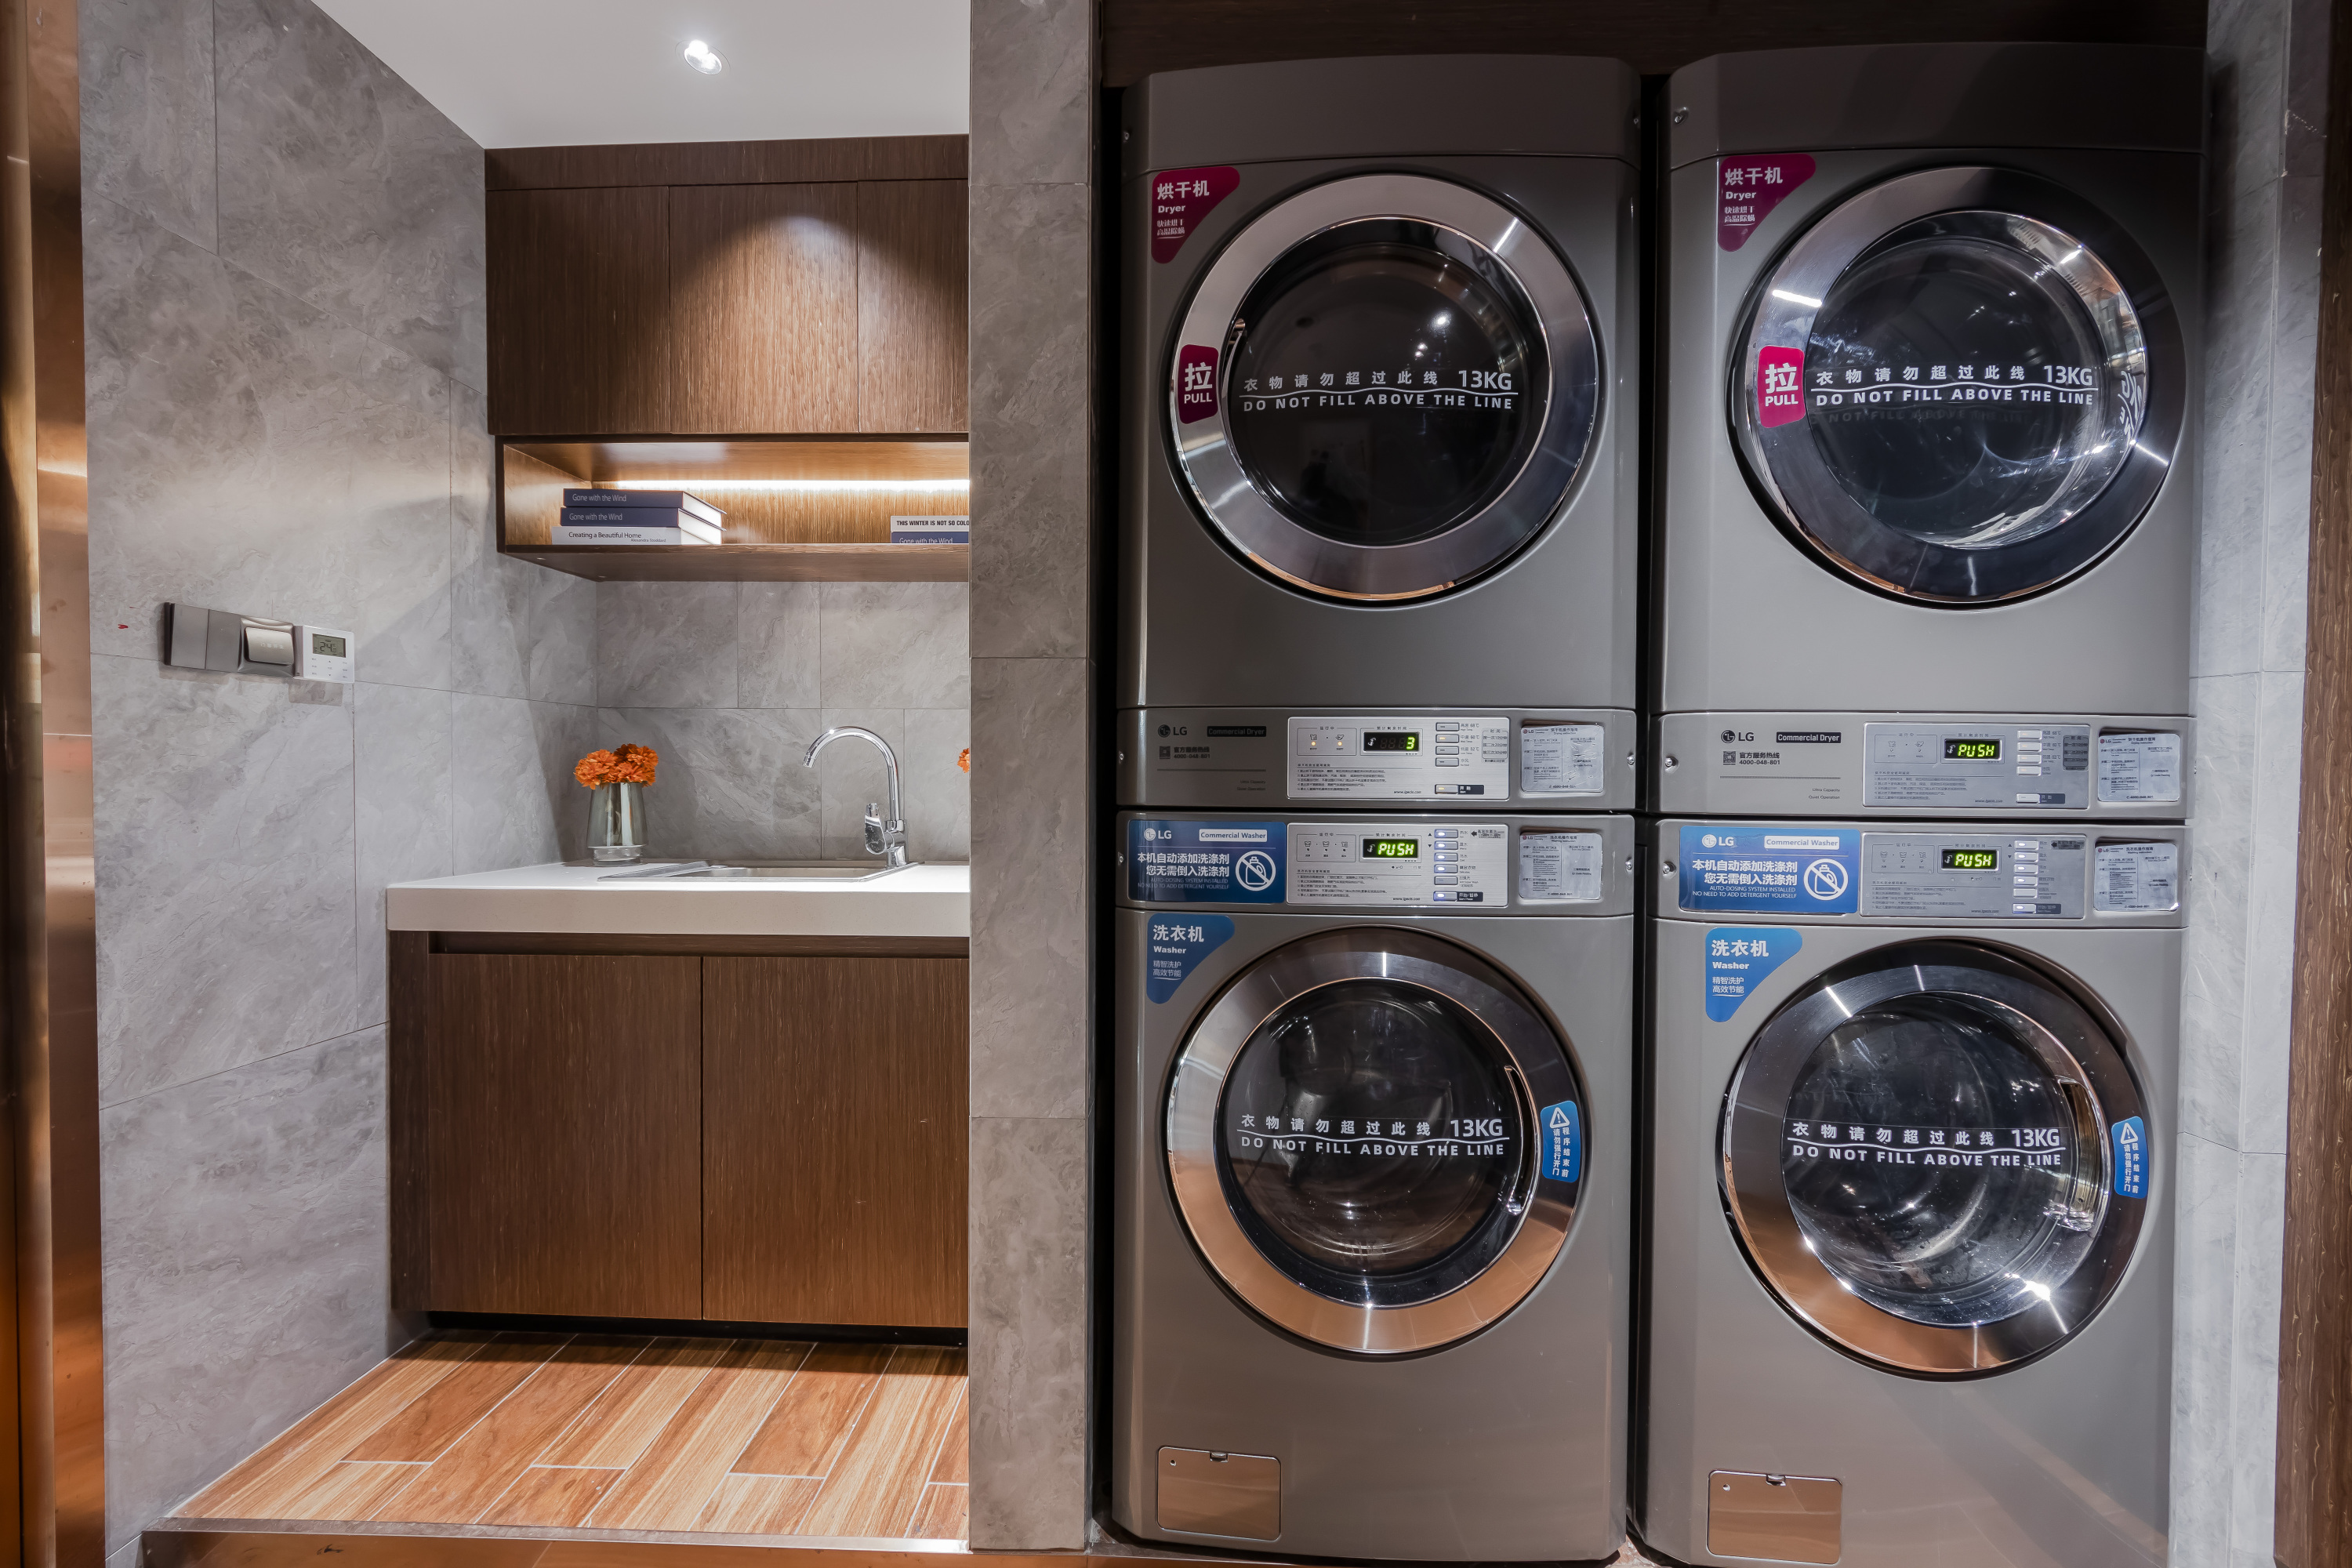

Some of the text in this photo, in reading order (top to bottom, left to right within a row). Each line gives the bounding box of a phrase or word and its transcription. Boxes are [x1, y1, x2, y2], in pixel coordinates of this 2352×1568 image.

[1725, 167, 1783, 186] 烘干机
[1157, 180, 1210, 200] 烘干机
[1726, 191, 1756, 201] Dryer
[1159, 205, 1185, 214] Dryer
[1185, 362, 1212, 391] 拉
[1244, 370, 1512, 392] 衣物请勿超过此线 13KG
[1766, 363, 1798, 394] 拉
[1817, 365, 2092, 386] 衣物请勿超过此线 13KG
[1184, 392, 1212, 405] PULL
[1244, 394, 1512, 412] DO NOT FILL ABOVE THE LINE
[1765, 395, 1798, 407] PULL
[1817, 389, 2092, 406] DO NOT FILL ABOVE THE LINE
[572, 494, 626, 503] Gone with the Wind
[1173, 726, 1187, 735] LG
[1738, 732, 1755, 742] LG
[1406, 737, 1415, 750] 3
[1820, 734, 1840, 742] Dryer
[1957, 743, 1995, 757] PUSH
[1158, 829, 1172, 840] LG
[1719, 837, 1734, 846] LG
[1377, 842, 1415, 856] PUSH
[1137, 852, 1230, 865] 本机自动添加洗涤剂
[1955, 853, 1993, 867] PUSH
[1146, 865, 1230, 877] 您无需倒入洗涤剂
[1692, 859, 1798, 873] 本机自动添加洗涤剂
[1704, 873, 1798, 886] 您无需倒入洗涤剂
[1152, 924, 1204, 942] 洗衣机
[1154, 946, 1187, 954] Washer
[1711, 939, 1769, 957] 洗衣机
[1152, 960, 1181, 968] 精智洗护
[1712, 961, 1750, 970] Washer
[1152, 969, 1181, 978] 高效节能
[1712, 985, 1744, 994] 高效节能
[1241, 1114, 1503, 1137] 衣物请勿超过此线 13KG
[1792, 1123, 2060, 1147] 衣物请勿超过此线 13KG
[1242, 1137, 1504, 1156] DO NOT FILL ABOVE THE LINE
[1552, 1129, 1562, 1176] 请勿强行开门
[1562, 1127, 1570, 1178] 程序结束前
[1792, 1146, 2061, 1167] DO NOT FILL ABOVE THE LINE
